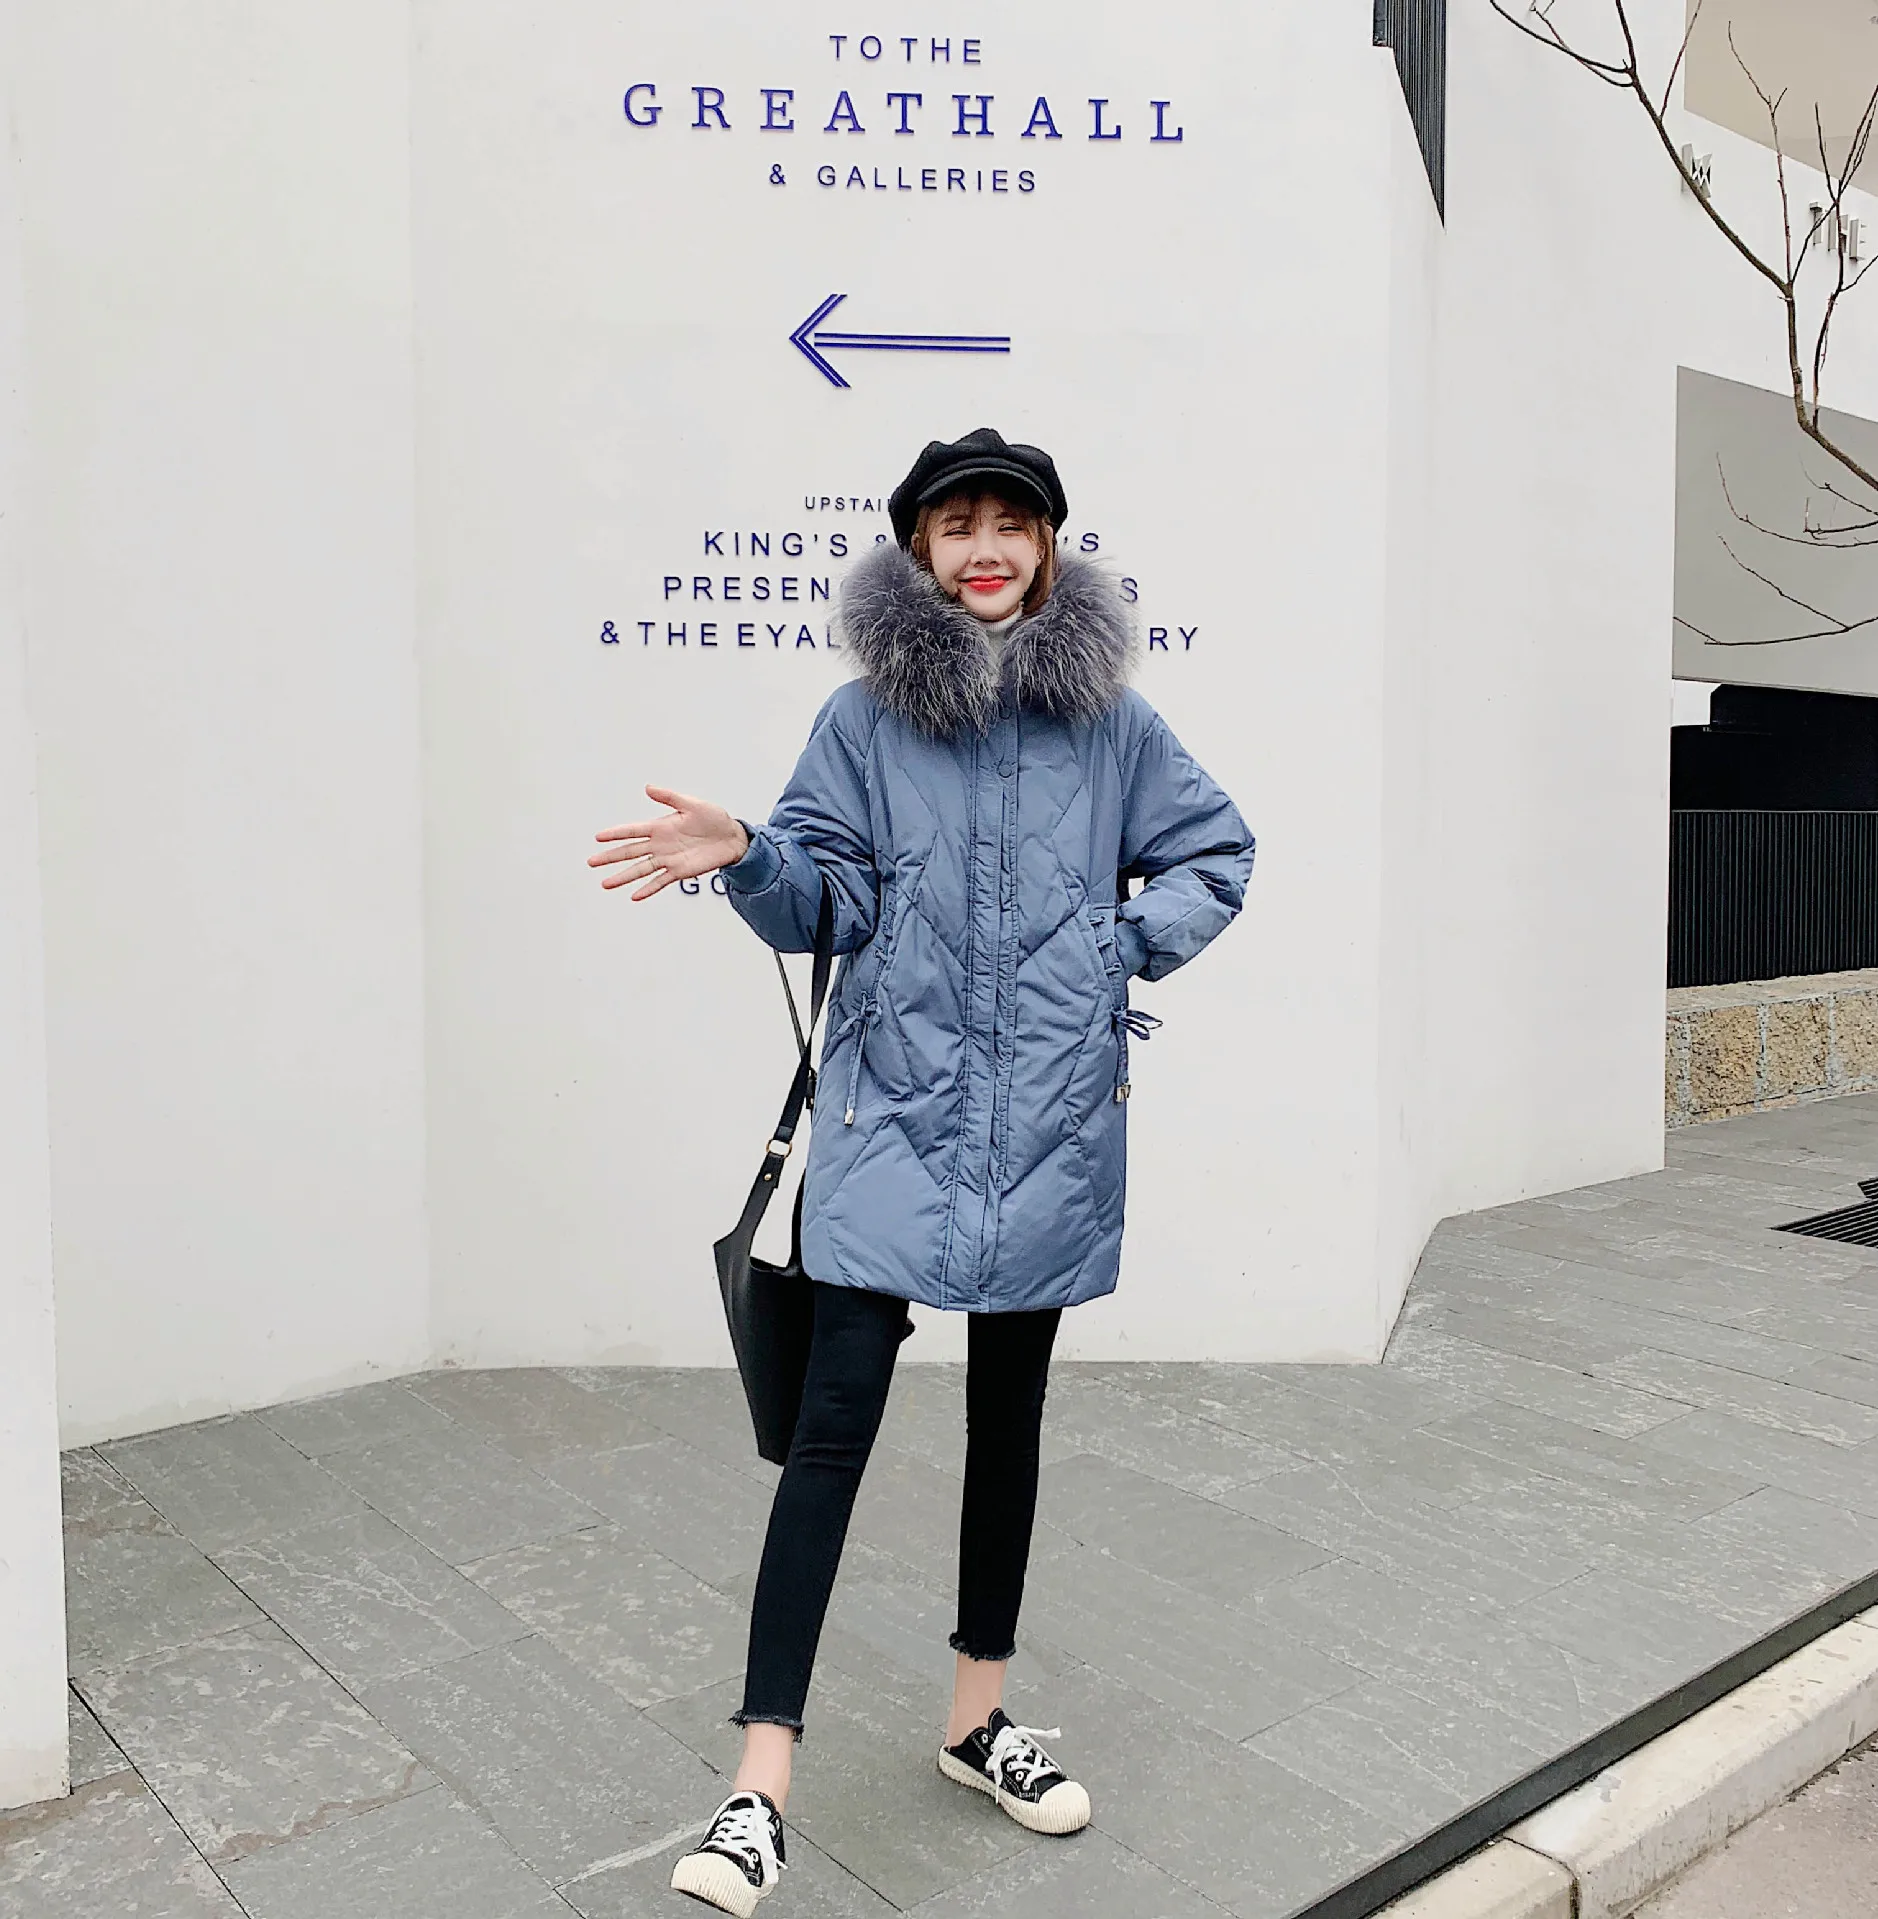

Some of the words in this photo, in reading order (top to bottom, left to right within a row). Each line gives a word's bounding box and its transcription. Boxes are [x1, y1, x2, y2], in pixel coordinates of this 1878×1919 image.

[829, 35, 883, 60] TO
[900, 37, 982, 64] THE
[769, 163, 786, 186] &
[817, 165, 1036, 193] GALLERIES
[805, 496, 892, 512] UPSTAI
[704, 531, 848, 558] KING'S
[663, 576, 844, 602] PRESEN
[600, 620, 620, 646] &
